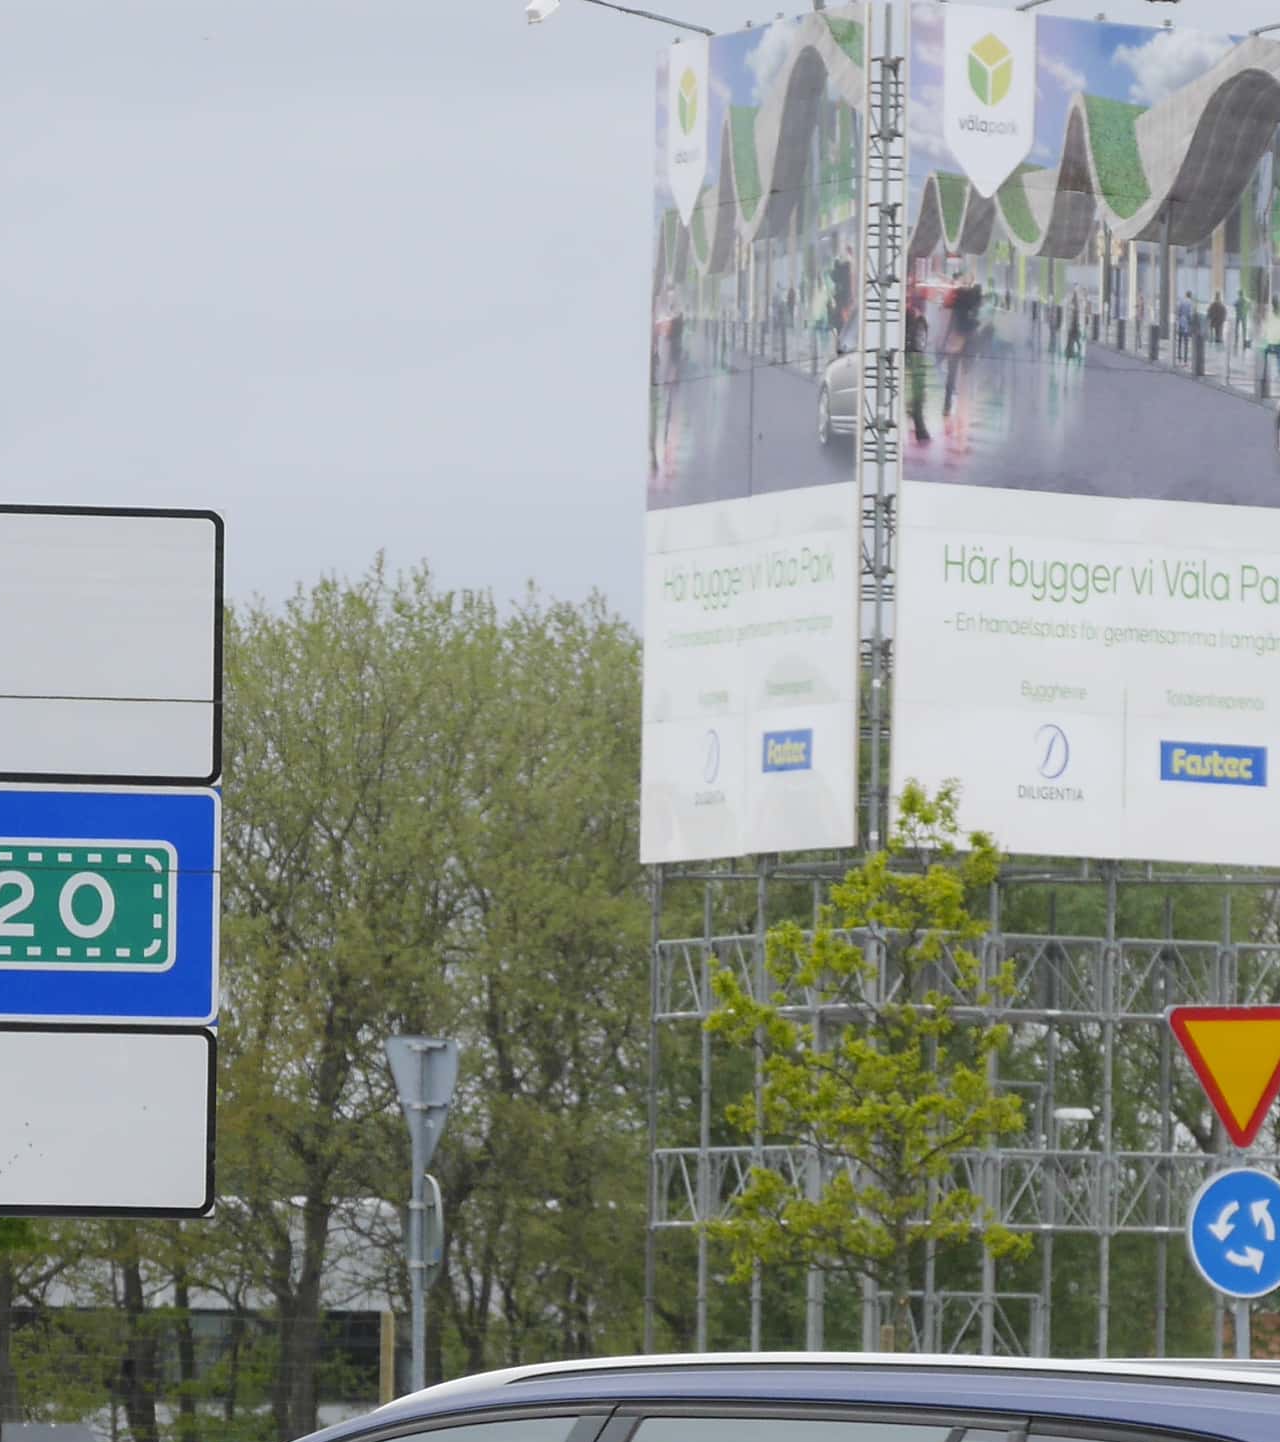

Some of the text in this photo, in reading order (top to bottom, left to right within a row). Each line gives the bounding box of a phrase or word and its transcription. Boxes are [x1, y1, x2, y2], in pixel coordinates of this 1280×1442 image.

[943, 543, 1000, 586] Här
[1007, 546, 1123, 604] bygger
[1130, 558, 1154, 596] vi
[1161, 558, 1231, 602] Väla
[1172, 748, 1253, 780] Fastec
[1017, 784, 1085, 802] DILIGENTIA
